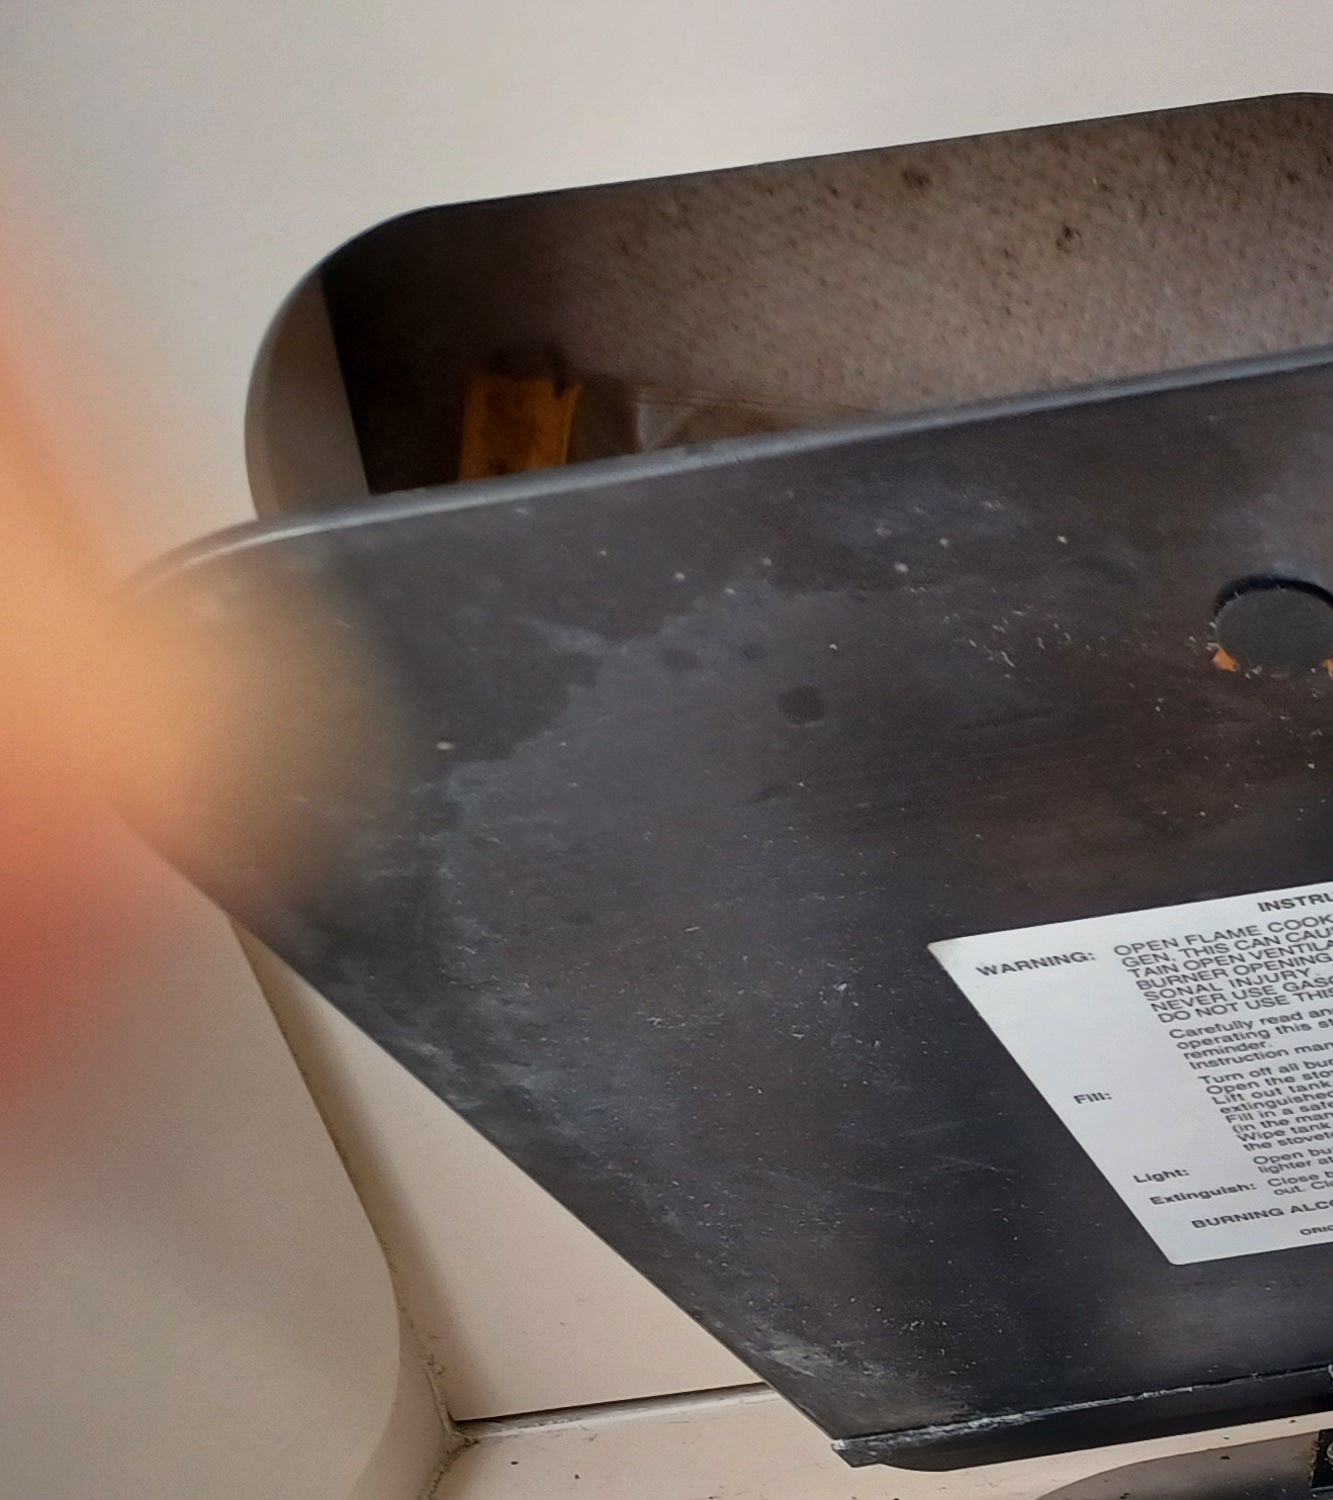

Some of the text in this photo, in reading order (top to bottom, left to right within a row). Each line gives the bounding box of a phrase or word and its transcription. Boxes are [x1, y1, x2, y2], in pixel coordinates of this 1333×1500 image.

[1113, 937, 1179, 956] OPEN
[1184, 924, 1261, 945] FLAME
[1179, 942, 1230, 958] THIS
[1233, 935, 1281, 951] CAN
[976, 951, 1095, 976] WARNING:
[1127, 963, 1180, 978] TAIN
[1182, 953, 1246, 971] OPEN
[1135, 968, 1229, 990] BURNER
[1143, 982, 1223, 1002] SONAL
[1150, 992, 1227, 1012] NEVER
[1230, 984, 1277, 1000] USE
[1157, 1009, 1191, 1023] DO
[1194, 1001, 1238, 1017] NOT
[1244, 994, 1290, 1010] USE
[1168, 1019, 1253, 1039] Carefully
[1259, 1010, 1304, 1025] read
[1073, 1091, 1112, 1104] Fill:
[1132, 1168, 1189, 1183] Light:
[1149, 1183, 1256, 1205] Extinguish:
[1191, 1207, 1284, 1228] BURNING
